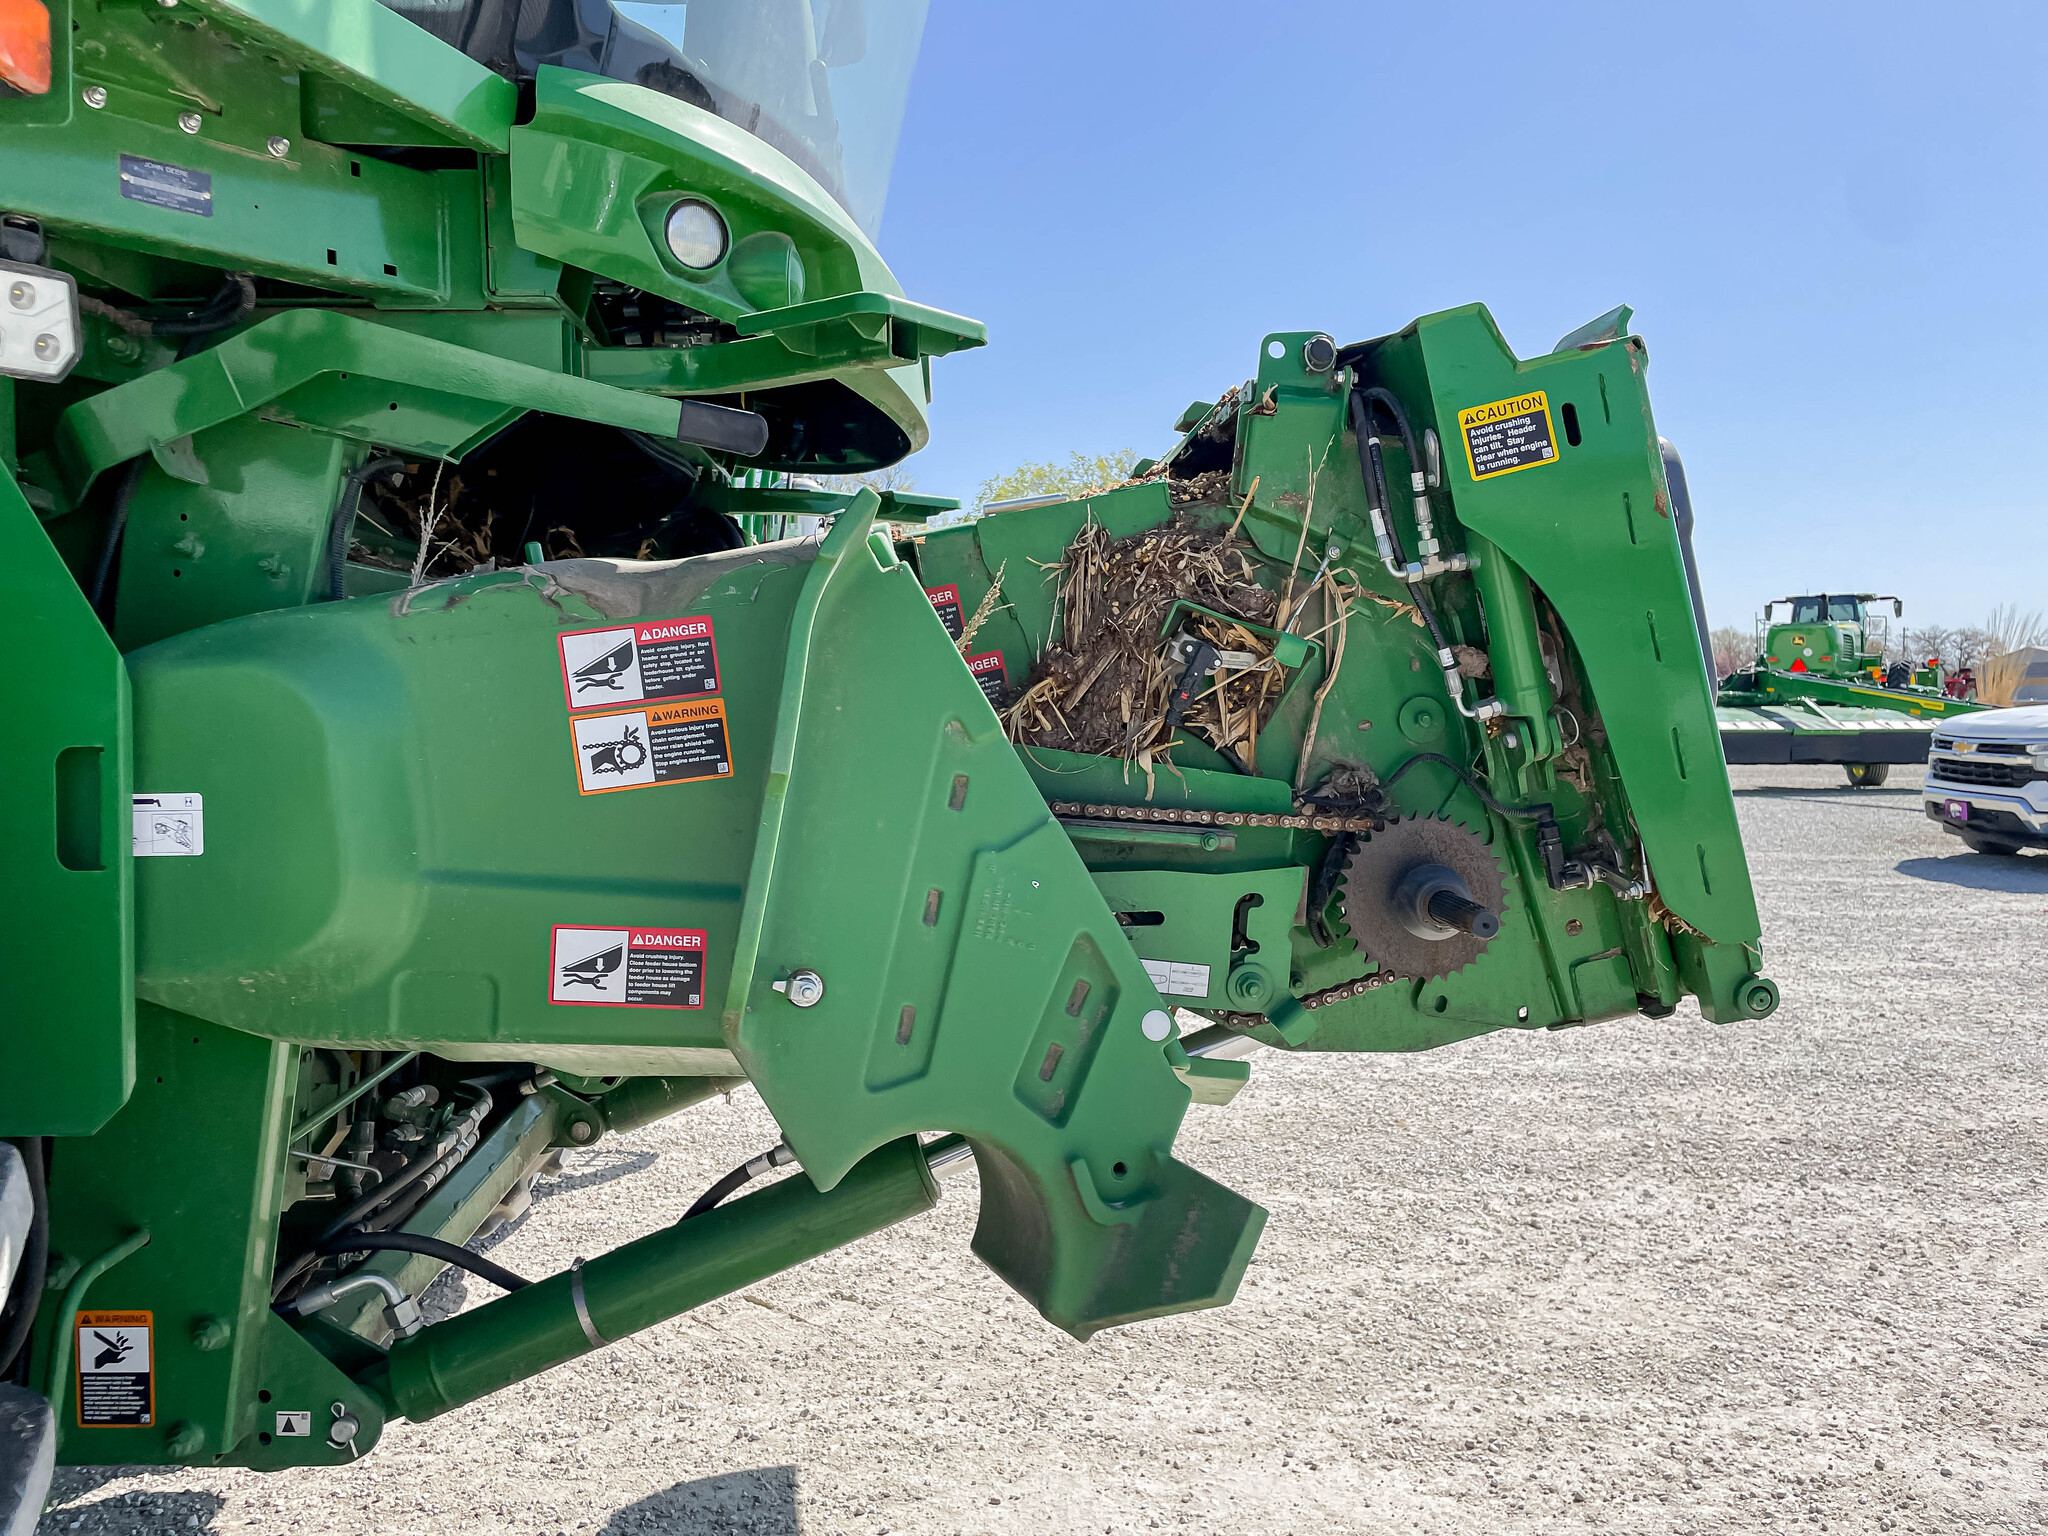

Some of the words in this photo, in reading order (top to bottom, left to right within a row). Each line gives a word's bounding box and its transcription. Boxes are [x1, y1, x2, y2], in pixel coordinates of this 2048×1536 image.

[1476, 395, 1543, 421] CAUTION
[1470, 426, 1493, 437] Avoid
[1495, 417, 1531, 430] crushing
[1472, 433, 1504, 446] injuries.
[1507, 424, 1536, 436] Header
[1474, 446, 1488, 454] can
[1507, 437, 1525, 446] Stay
[1476, 453, 1495, 462] clear
[1497, 446, 1519, 457] when
[1520, 440, 1548, 452] engine
[1487, 456, 1520, 468] running.
[929, 591, 953, 603] GER
[652, 623, 707, 639] DANGER
[967, 657, 999, 671] NGER
[662, 705, 718, 720] WARNING
[668, 732, 706, 741] entanglement.
[645, 934, 701, 947] DANGER
